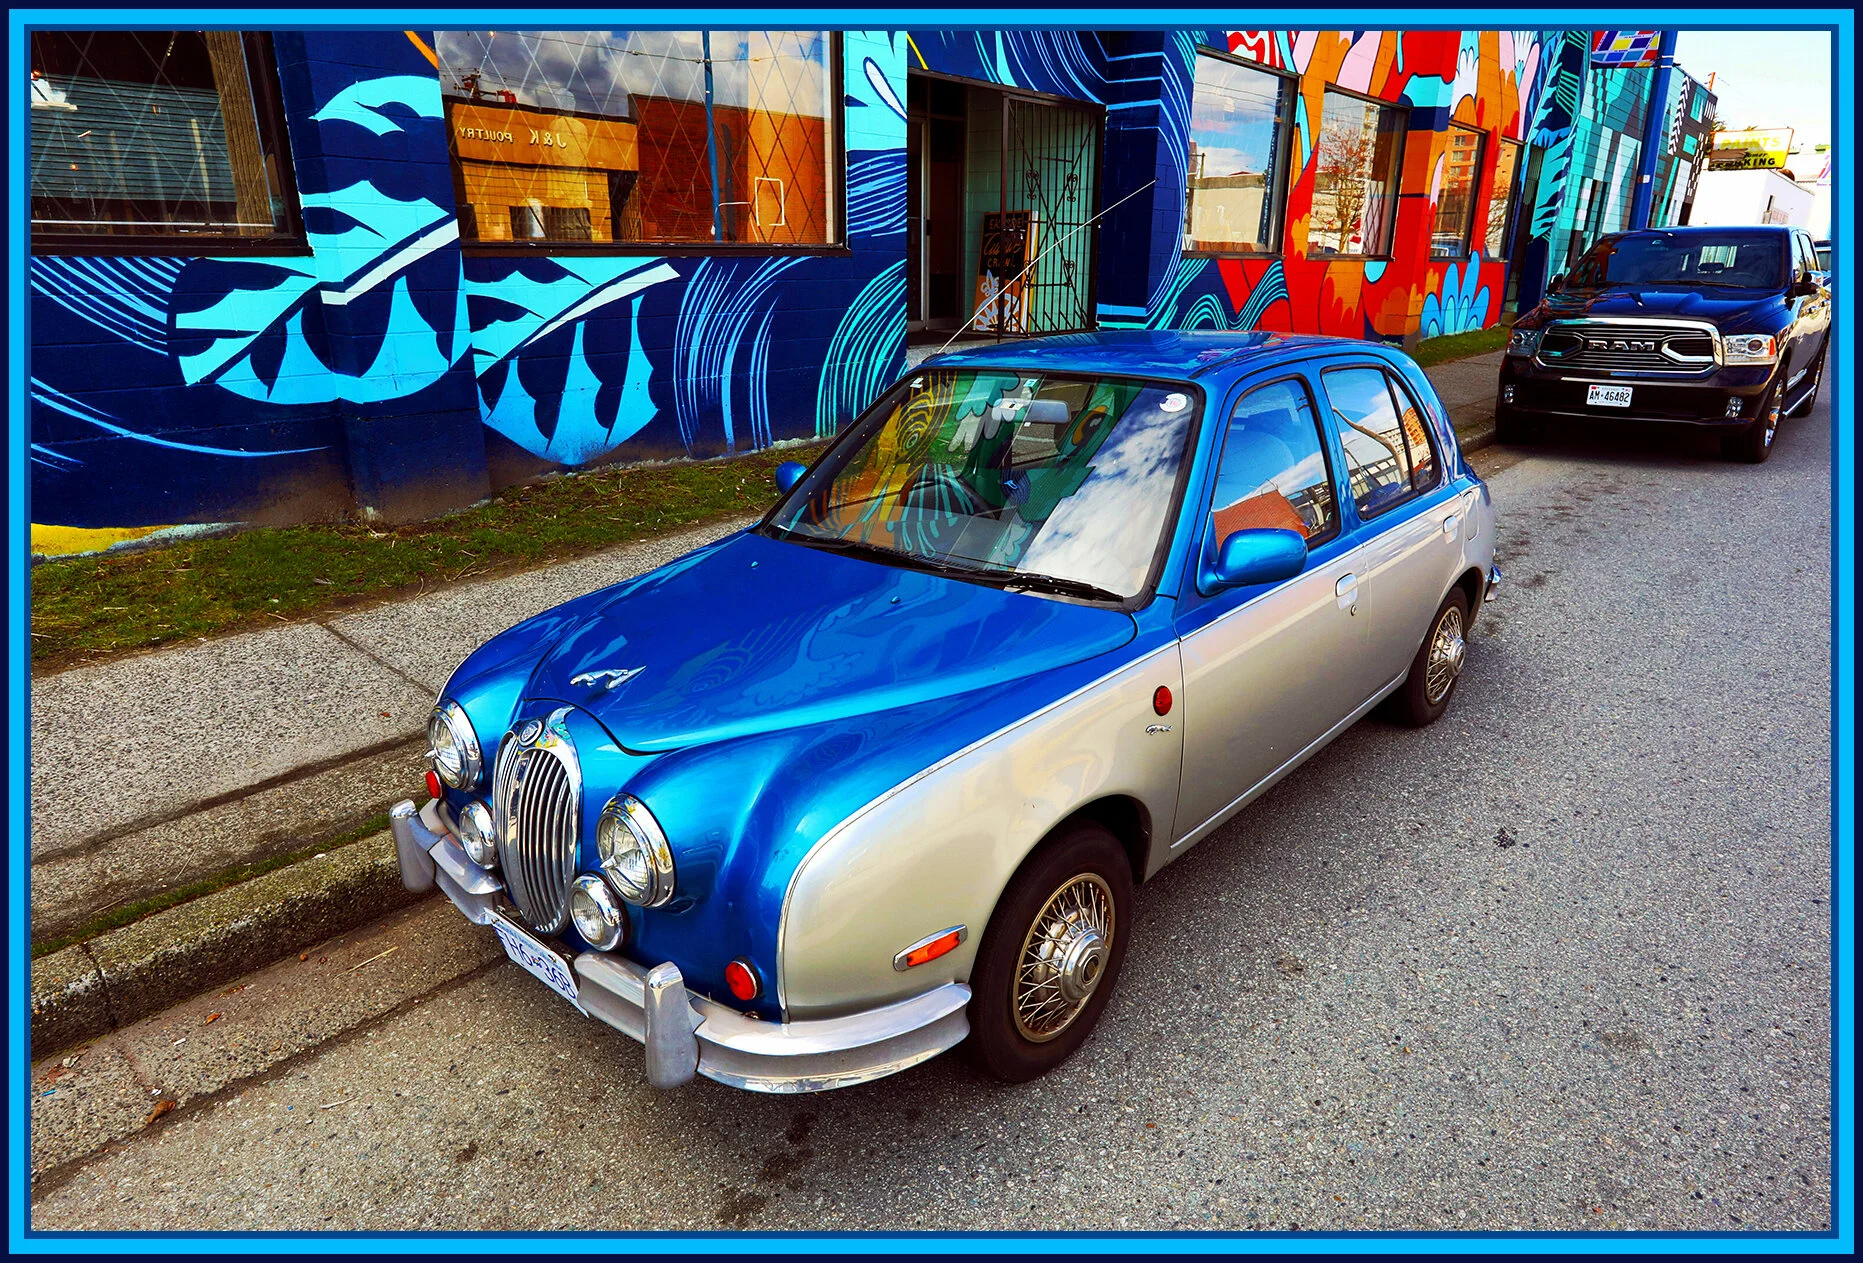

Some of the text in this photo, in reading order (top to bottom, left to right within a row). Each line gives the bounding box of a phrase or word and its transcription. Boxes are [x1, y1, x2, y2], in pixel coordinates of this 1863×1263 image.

[1721, 137, 1780, 149] PAINTS
[1588, 340, 1655, 351] RAM
[1604, 391, 1630, 403] 46482
